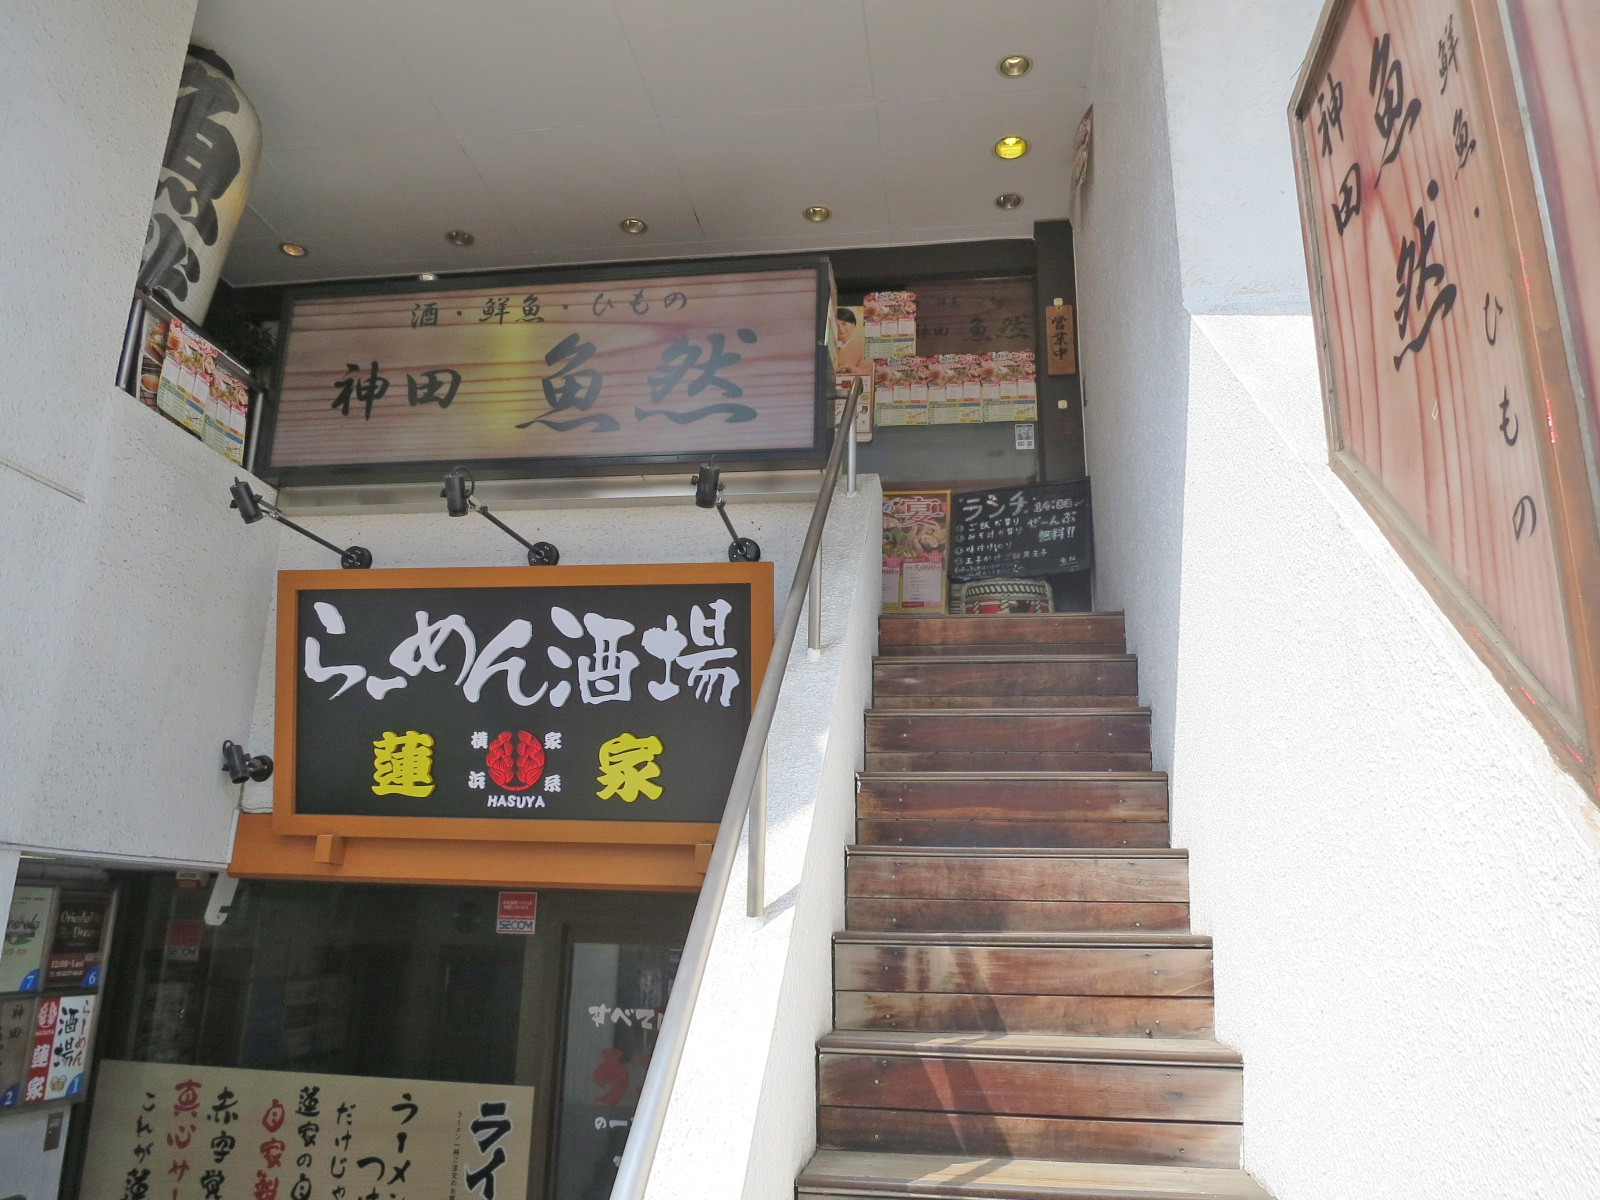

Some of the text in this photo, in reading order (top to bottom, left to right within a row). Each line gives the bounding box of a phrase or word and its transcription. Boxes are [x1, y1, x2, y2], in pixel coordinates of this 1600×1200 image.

[1317, 73, 1361, 236] 神田
[331, 331, 758, 437] 神田 魚然
[371, 731, 664, 803] 蓮 家
[487, 795, 546, 808] HASUYA
[499, 921, 533, 930] SECOM
[88, 971, 97, 985] 6
[588, 1003, 664, 1030] すべて
